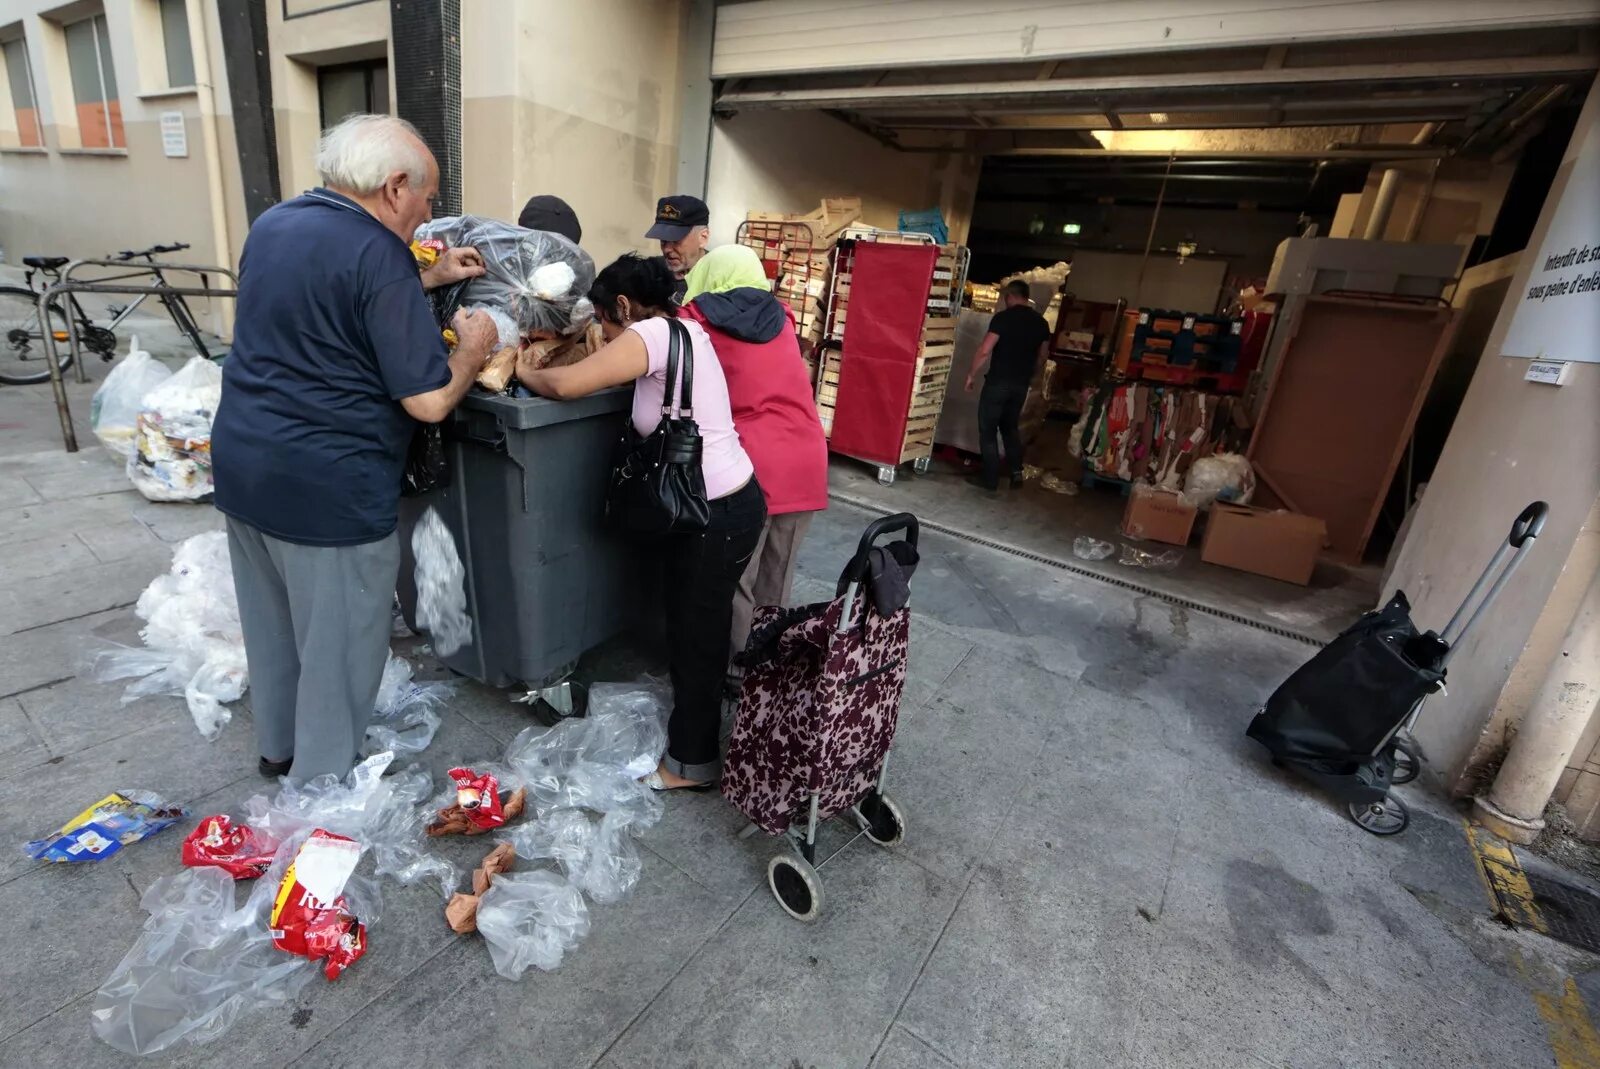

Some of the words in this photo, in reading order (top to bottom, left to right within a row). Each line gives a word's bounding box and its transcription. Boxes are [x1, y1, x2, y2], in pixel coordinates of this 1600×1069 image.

[1543, 247, 1577, 272] Interdit
[1576, 244, 1589, 264] de
[1527, 285, 1546, 300] sous
[1542, 277, 1569, 302] peine
